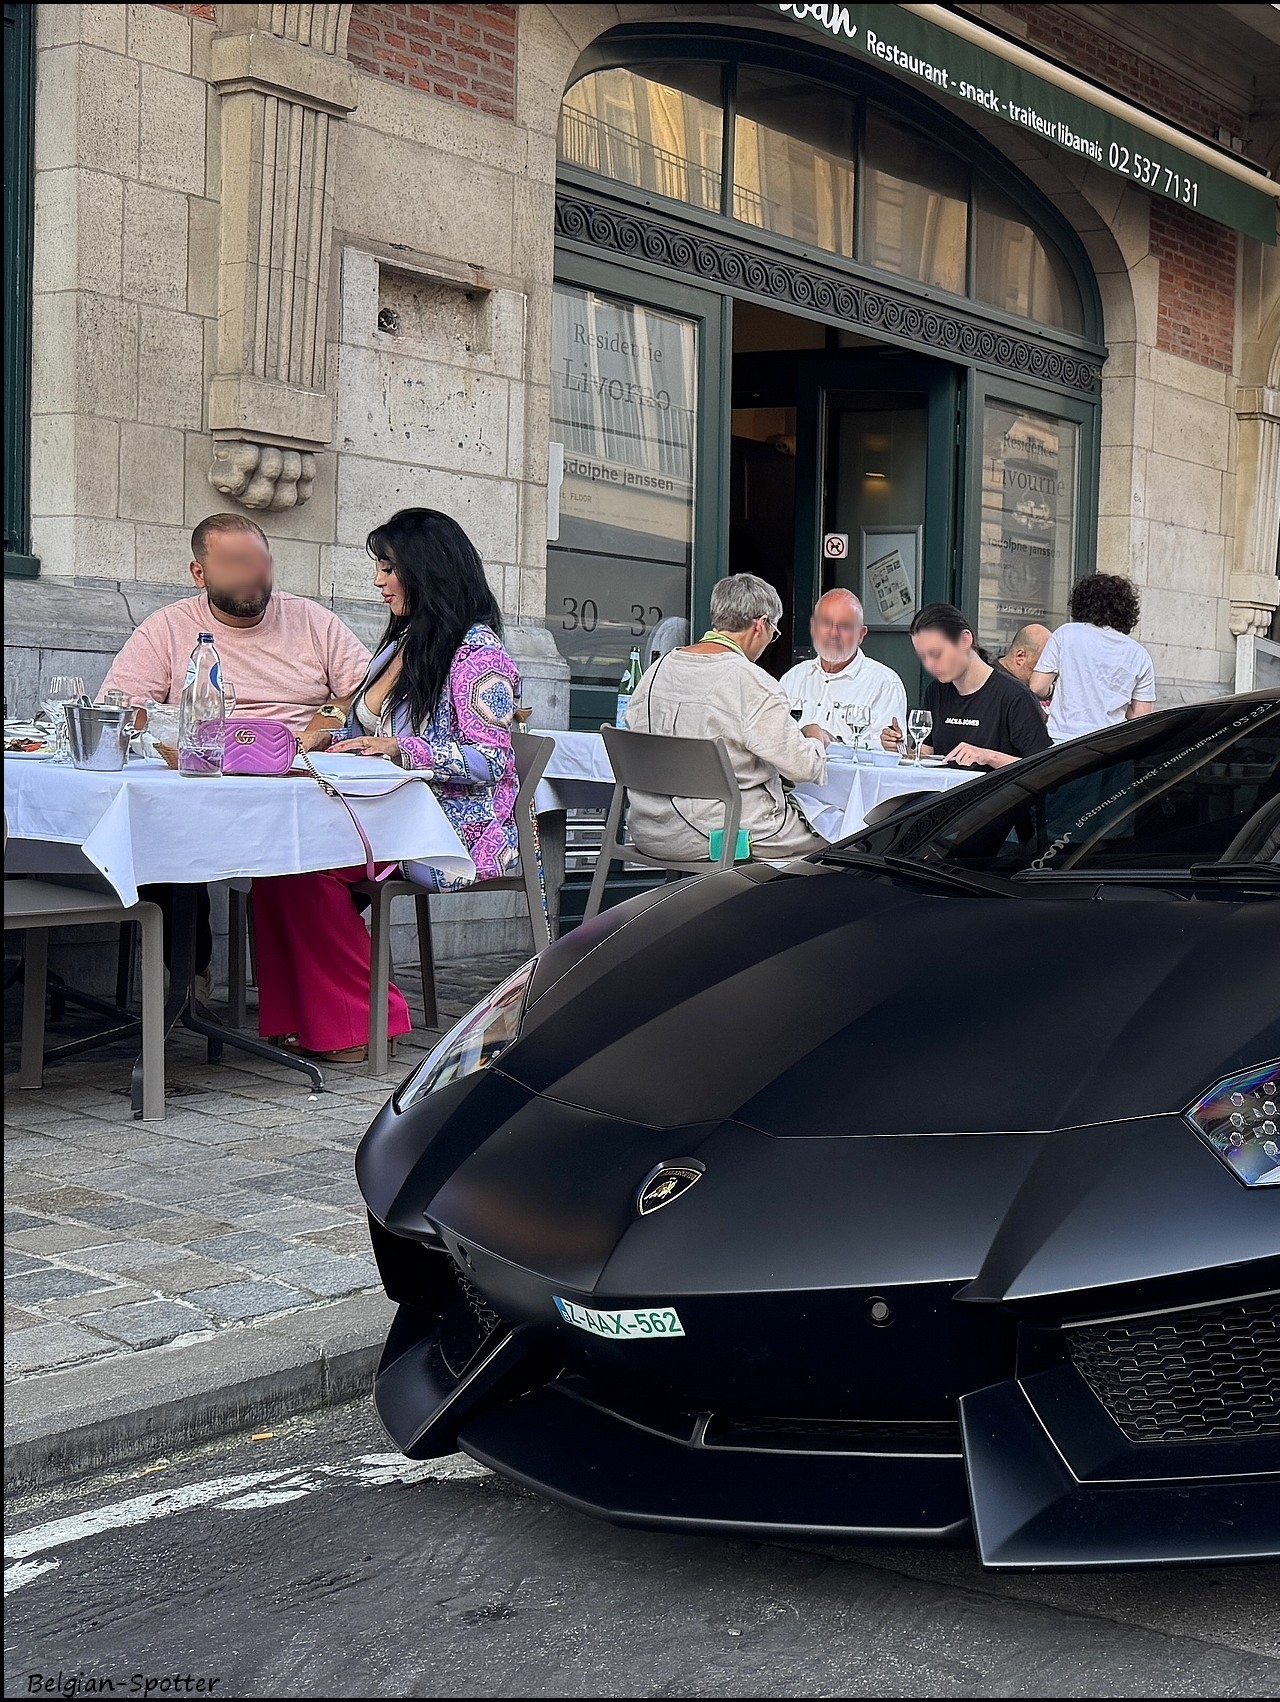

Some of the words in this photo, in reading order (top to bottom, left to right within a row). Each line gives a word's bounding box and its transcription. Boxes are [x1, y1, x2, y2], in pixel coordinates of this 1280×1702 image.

[866, 29, 949, 89] Restaurant
[959, 81, 1000, 113] snack
[1009, 101, 1057, 138] traiteur
[1057, 121, 1103, 162] libanais
[1109, 142, 1130, 174] 02
[1133, 152, 1161, 187] 537
[562, 357, 671, 411] Livorno
[623, 468, 674, 491] janssen
[990, 457, 1066, 498] Livourne
[562, 597, 599, 633] 30
[565, 1302, 682, 1335] Z-AAX-562
